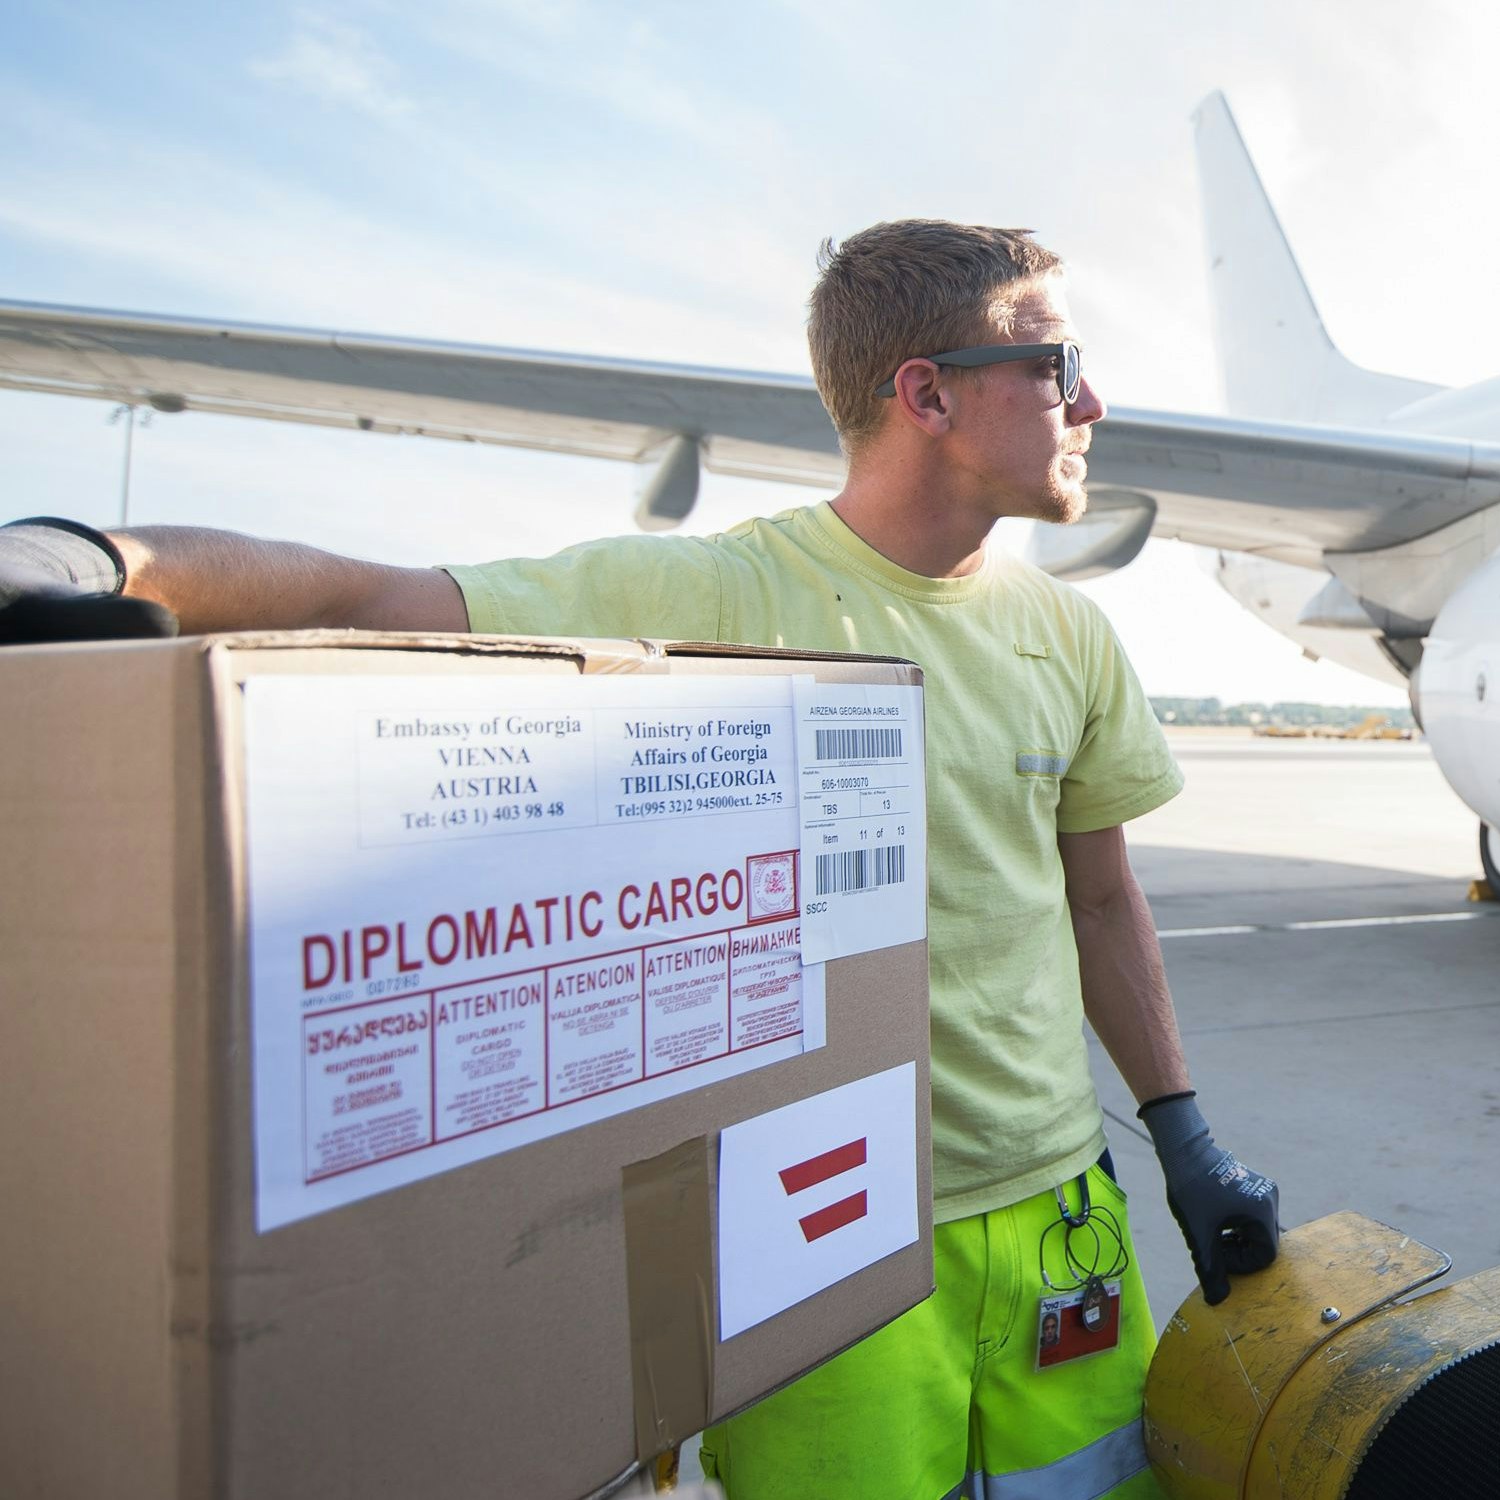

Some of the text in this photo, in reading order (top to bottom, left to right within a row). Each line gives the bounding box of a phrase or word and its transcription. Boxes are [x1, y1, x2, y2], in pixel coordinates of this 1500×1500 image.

[809, 706, 899, 716] AIRZENA GEORGIAN AIRLINES
[375, 715, 582, 741] Embassy of Georgia
[624, 719, 771, 742] Ministry of Foreign
[438, 746, 531, 767] VIENNA
[630, 744, 768, 766] Affairs of Georgia
[431, 775, 539, 800] AUSTRIA
[620, 769, 777, 795] TBILISI,GEORGIA
[821, 777, 869, 790] 606-10003070
[402, 801, 564, 830] Tel: (43 1) 403 98 48
[615, 792, 783, 819] Tel:(995 32)2 945000ext. 25-75
[822, 803, 838, 815] TBS
[882, 799, 891, 810] 13
[823, 825, 905, 844] Item 11 of 13
[806, 901, 828, 915] SSCC
[302, 890, 604, 991] DIPLOMATIC
[617, 868, 744, 931] CARGO
[732, 927, 801, 959] ВНИМАНИЕ
[646, 943, 726, 978] ATTENTION
[554, 962, 635, 999] ATENCION
[647, 984, 674, 997] VALISE
[674, 971, 726, 991] DIPLOMATIQUE
[437, 983, 541, 1026] ATTENTION
[307, 1009, 430, 1056] ყურადღება
[455, 1020, 526, 1045] DIPLOMATIC
[471, 1037, 513, 1056] CARGO
